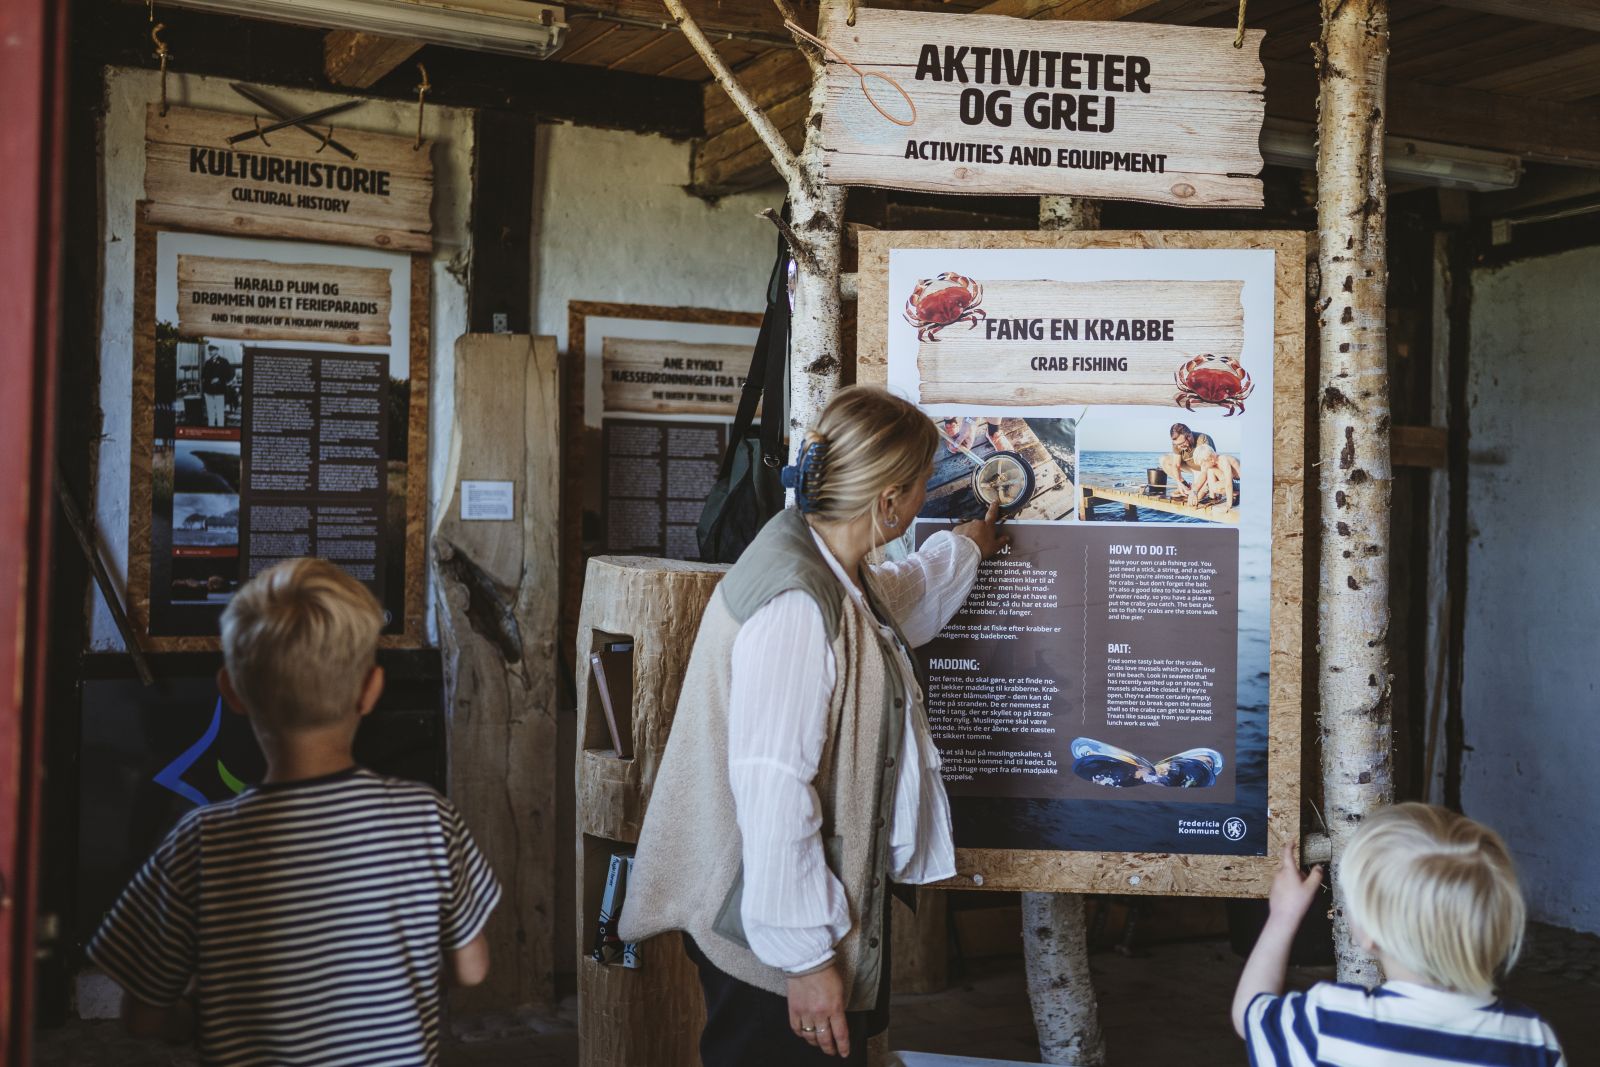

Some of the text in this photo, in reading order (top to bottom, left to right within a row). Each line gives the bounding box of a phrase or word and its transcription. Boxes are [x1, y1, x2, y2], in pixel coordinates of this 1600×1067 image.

[915, 44, 1151, 93] AKTIVITETER
[960, 88, 1115, 133] OG GREJ
[905, 140, 1167, 173] ACTIVITIES AND EQUIPMENT
[189, 147, 390, 196] KULTURHISTORIE
[232, 187, 350, 213] CULTURAL HISTORY
[234, 277, 339, 296] HARALD PLUM OG
[192, 291, 378, 315] DRØMMEN OM ET FERIEPARADIS
[211, 314, 360, 330] AND THE DREAM OF A HOLIDAY PARADISE
[986, 319, 1174, 341] FANG EN KRABBE
[663, 358, 683, 370] ANE
[1031, 356, 1128, 372] CRAB FISHING
[715, 376, 734, 387] FRA
[1110, 545, 1177, 556] HOW TO DO IT:
[1108, 644, 1131, 653] BAIT:
[930, 659, 980, 670] MADDING:
